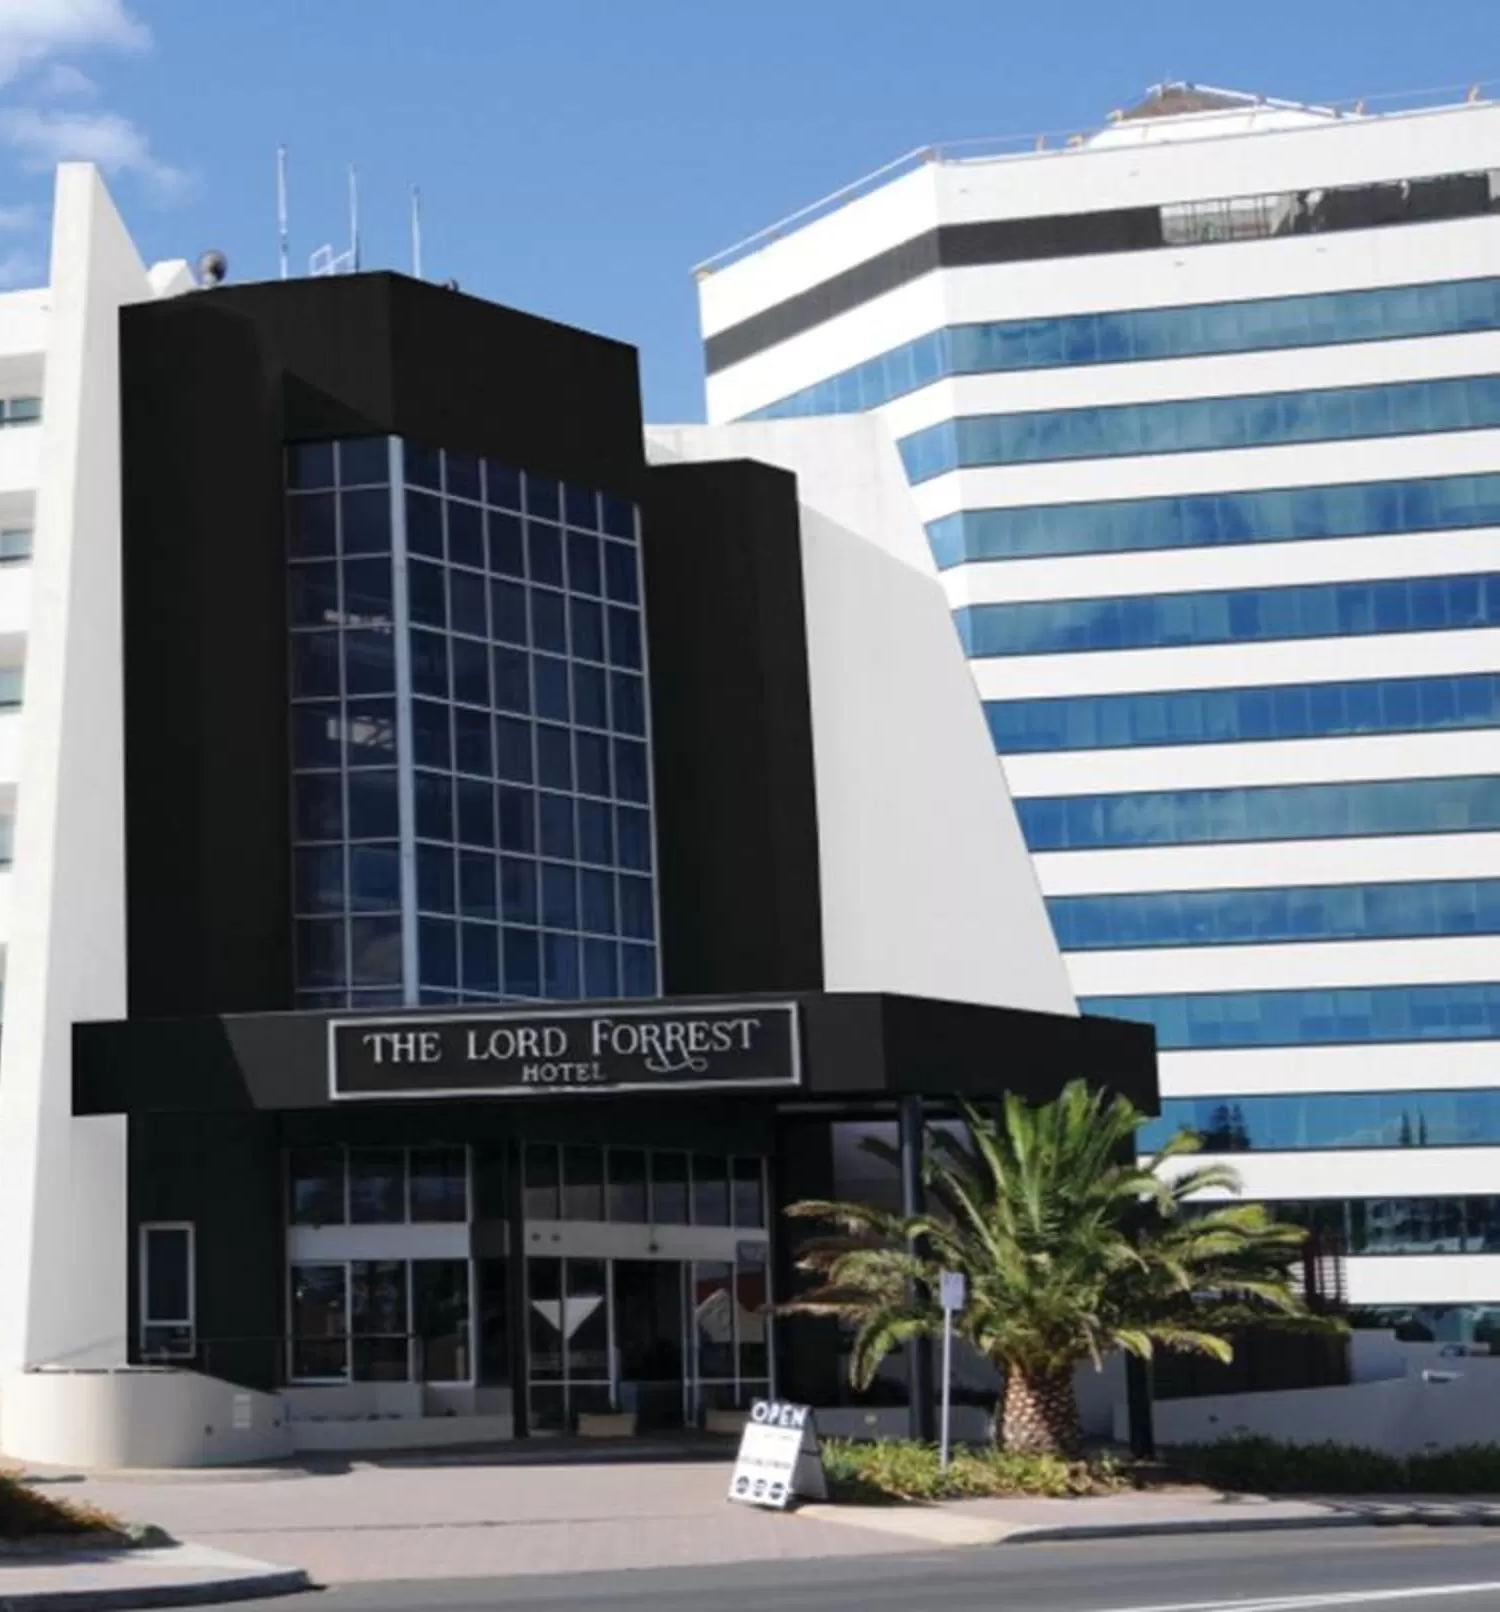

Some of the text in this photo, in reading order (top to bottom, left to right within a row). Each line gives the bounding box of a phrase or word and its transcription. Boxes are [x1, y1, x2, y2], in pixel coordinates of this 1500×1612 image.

[361, 1018, 761, 1073] THE LORD FORREST
[521, 1061, 607, 1083] HOTEL
[751, 1401, 808, 1427] OPEN
